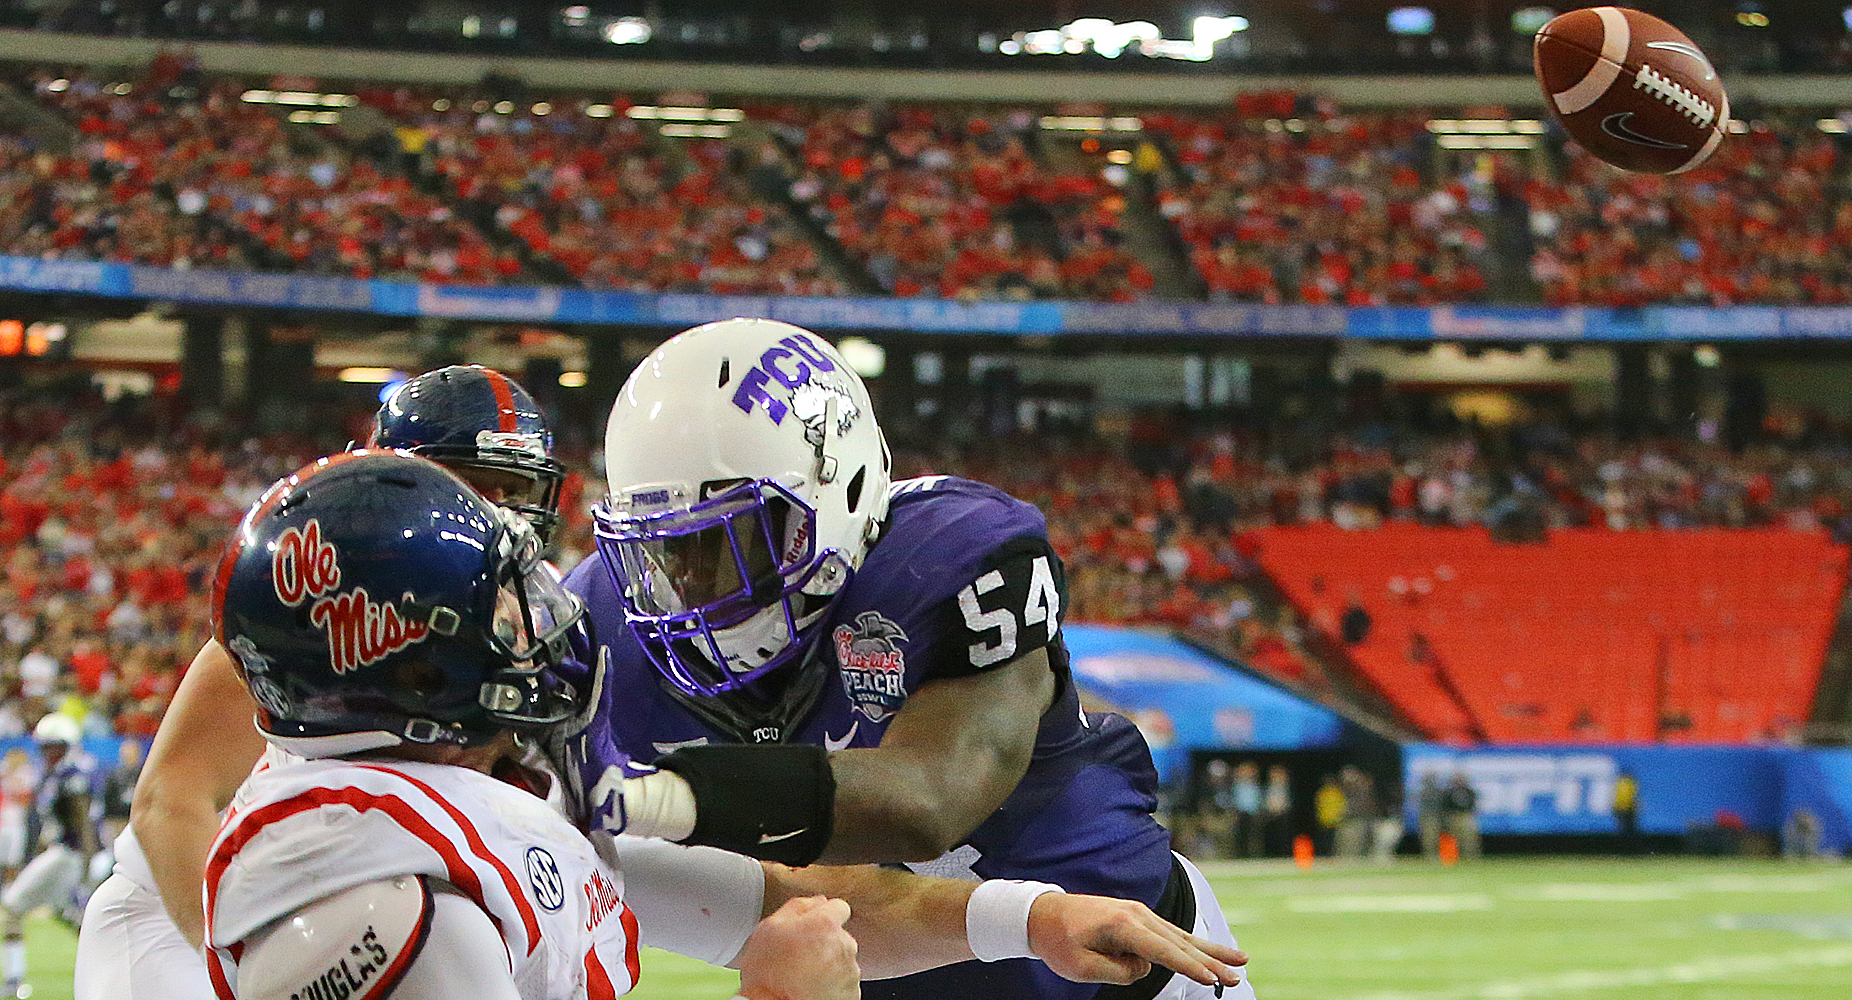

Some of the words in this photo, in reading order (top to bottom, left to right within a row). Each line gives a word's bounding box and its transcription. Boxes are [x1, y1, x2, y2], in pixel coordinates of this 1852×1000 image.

[732, 335, 834, 426] TCU
[632, 489, 669, 506] FROGS
[273, 518, 341, 607] Ole
[957, 555, 1060, 668] 54
[841, 670, 900, 697] PEACH
[752, 727, 779, 743] TCU
